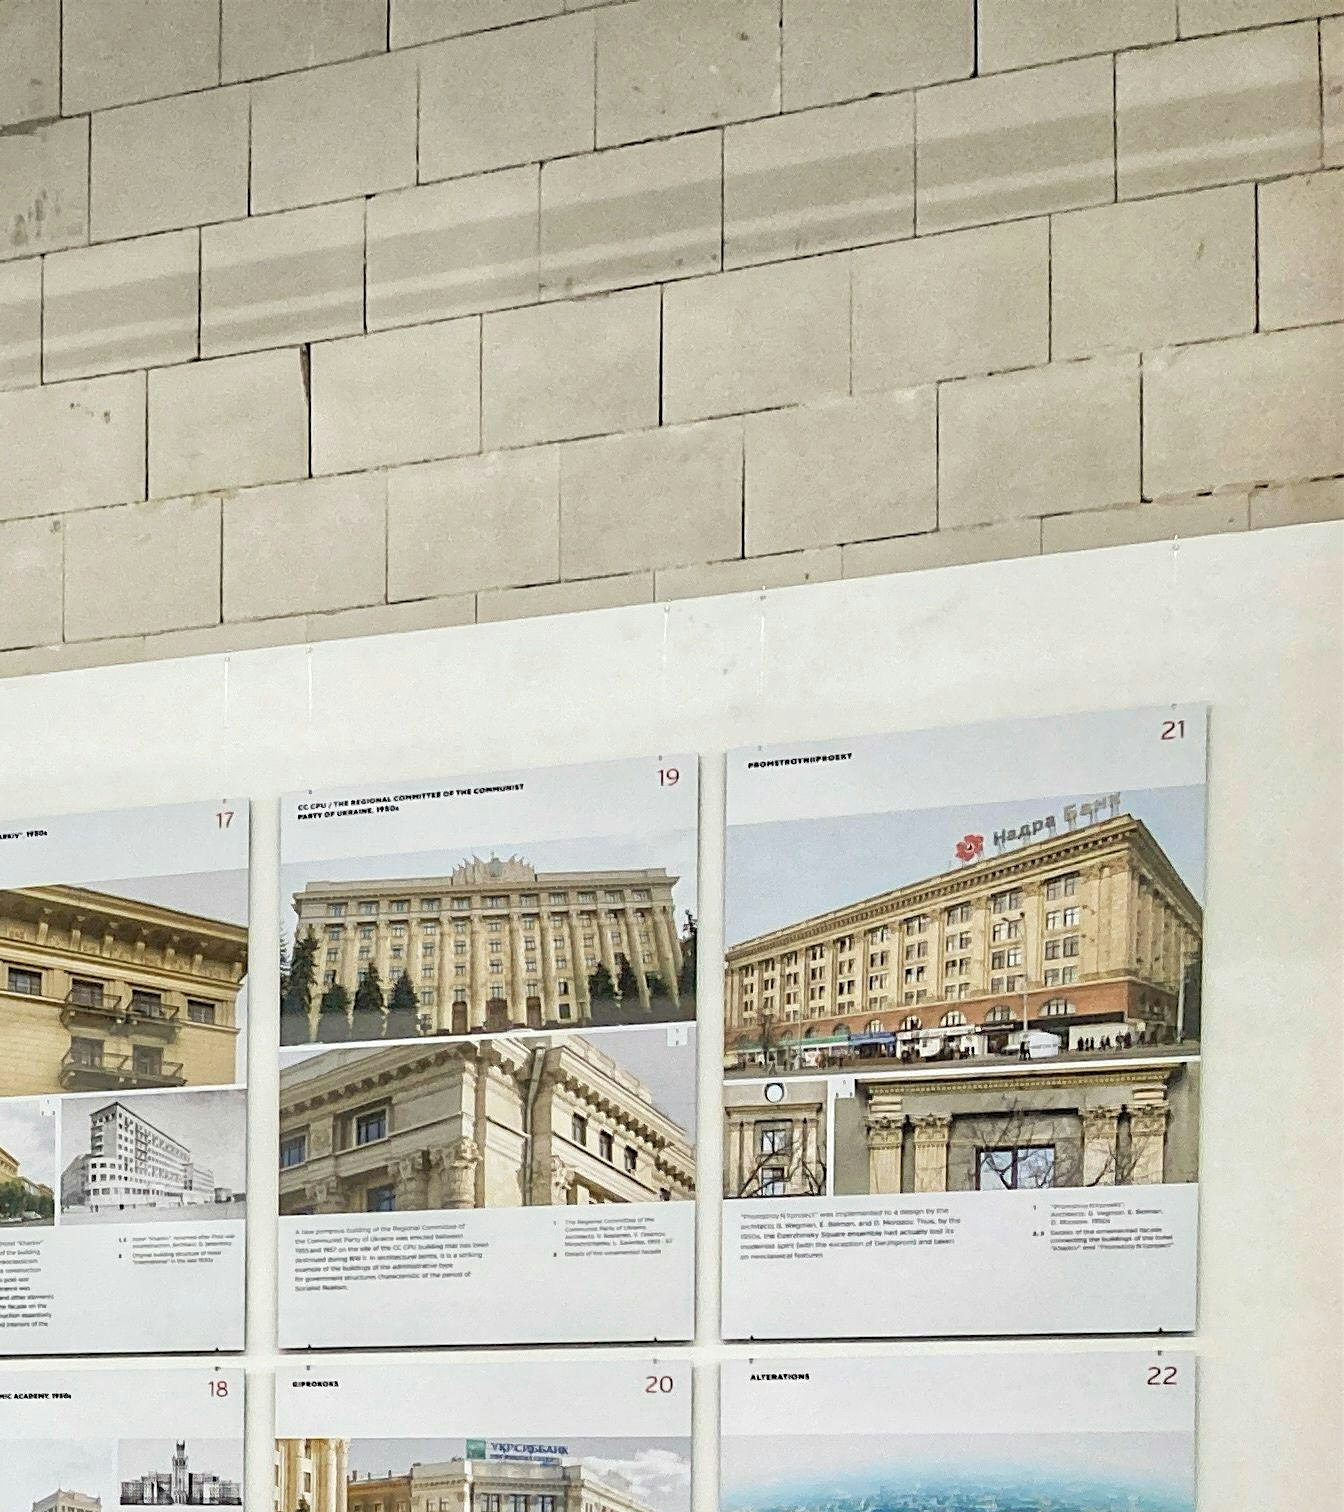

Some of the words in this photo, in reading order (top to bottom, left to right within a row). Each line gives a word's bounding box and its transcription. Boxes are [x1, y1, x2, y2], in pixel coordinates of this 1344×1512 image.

[1160, 720, 1184, 740] 21
[658, 768, 679, 786] 19
[297, 803, 308, 811] CC
[350, 796, 391, 806] REGIONAL
[392, 791, 441, 802] COMMITTEE
[473, 783, 524, 794] COMMUNIST
[215, 811, 234, 829] 17
[297, 812, 322, 820] PARTY
[645, 1375, 673, 1393] 20
[750, 1373, 810, 1381] ALTERATIONS
[1146, 1366, 1177, 1385] 22
[208, 1380, 228, 1397] 18
